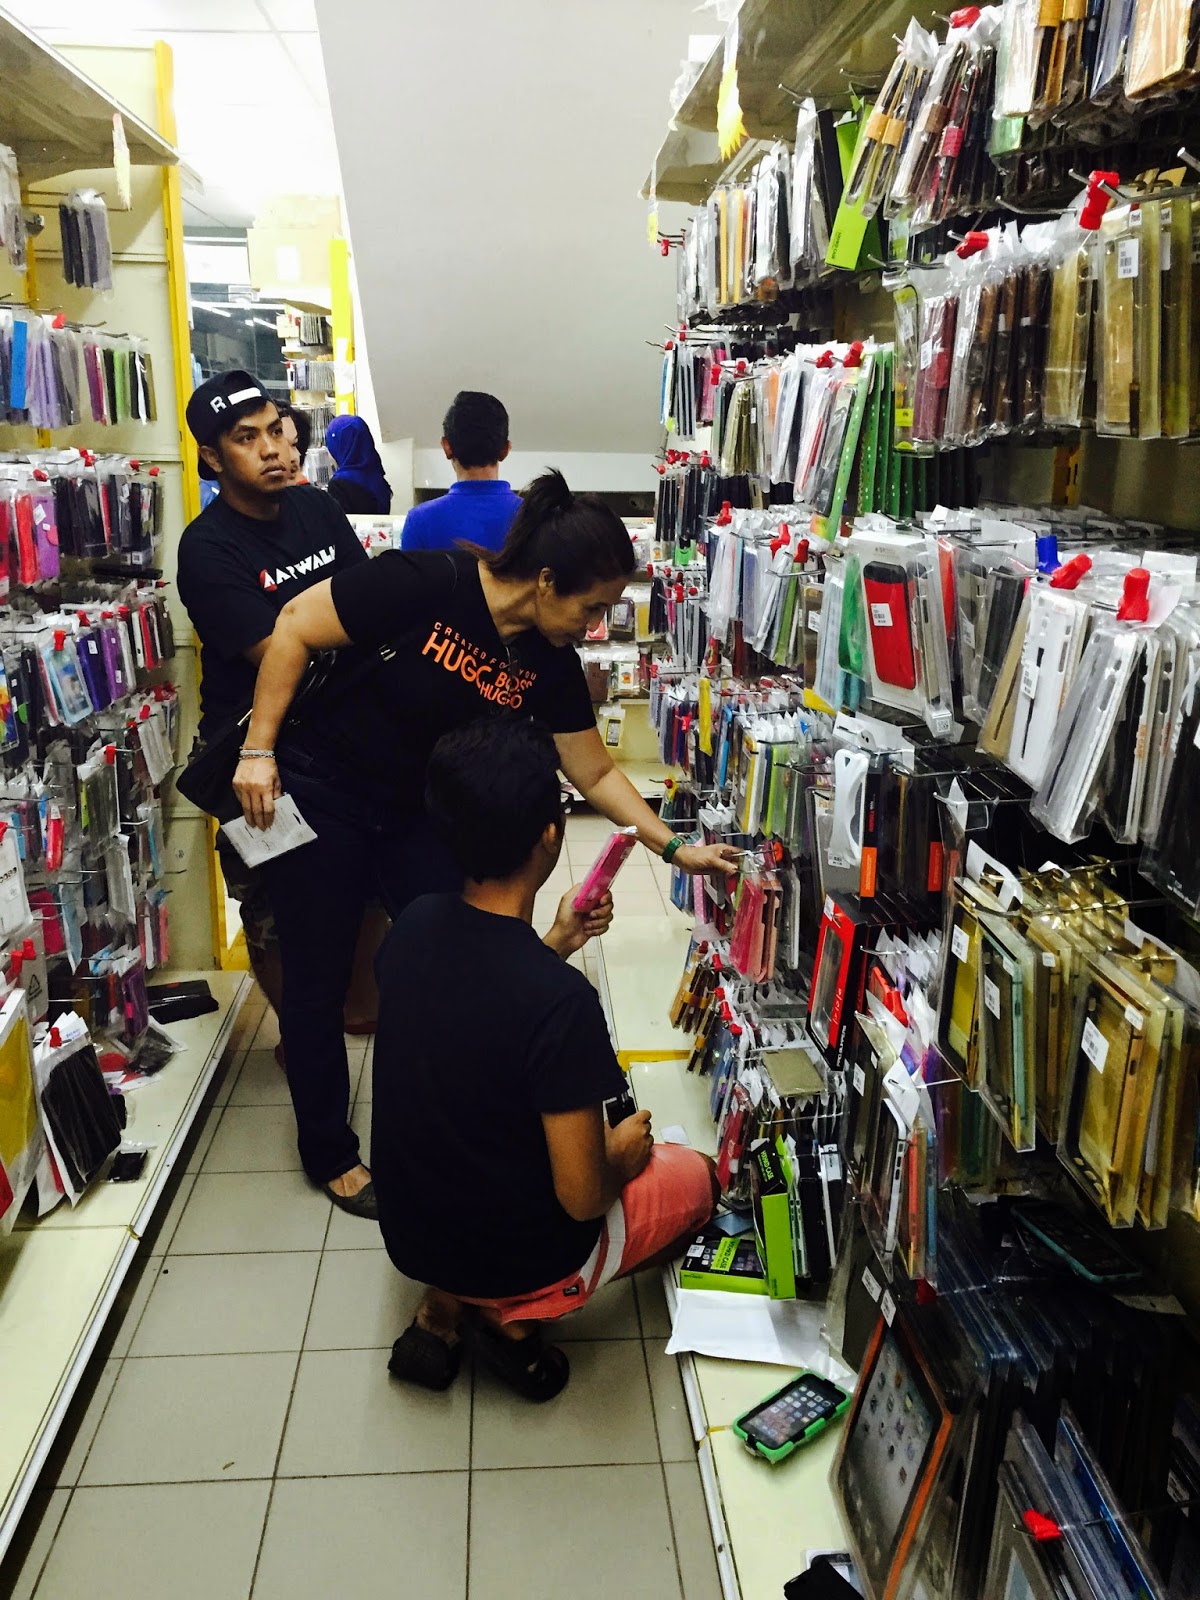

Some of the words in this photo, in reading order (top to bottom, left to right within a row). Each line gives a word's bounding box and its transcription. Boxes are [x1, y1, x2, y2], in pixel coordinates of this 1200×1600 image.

[434, 621, 487, 660] CREATED
[519, 668, 537, 681] YOU
[480, 681, 523, 709] HUGO
